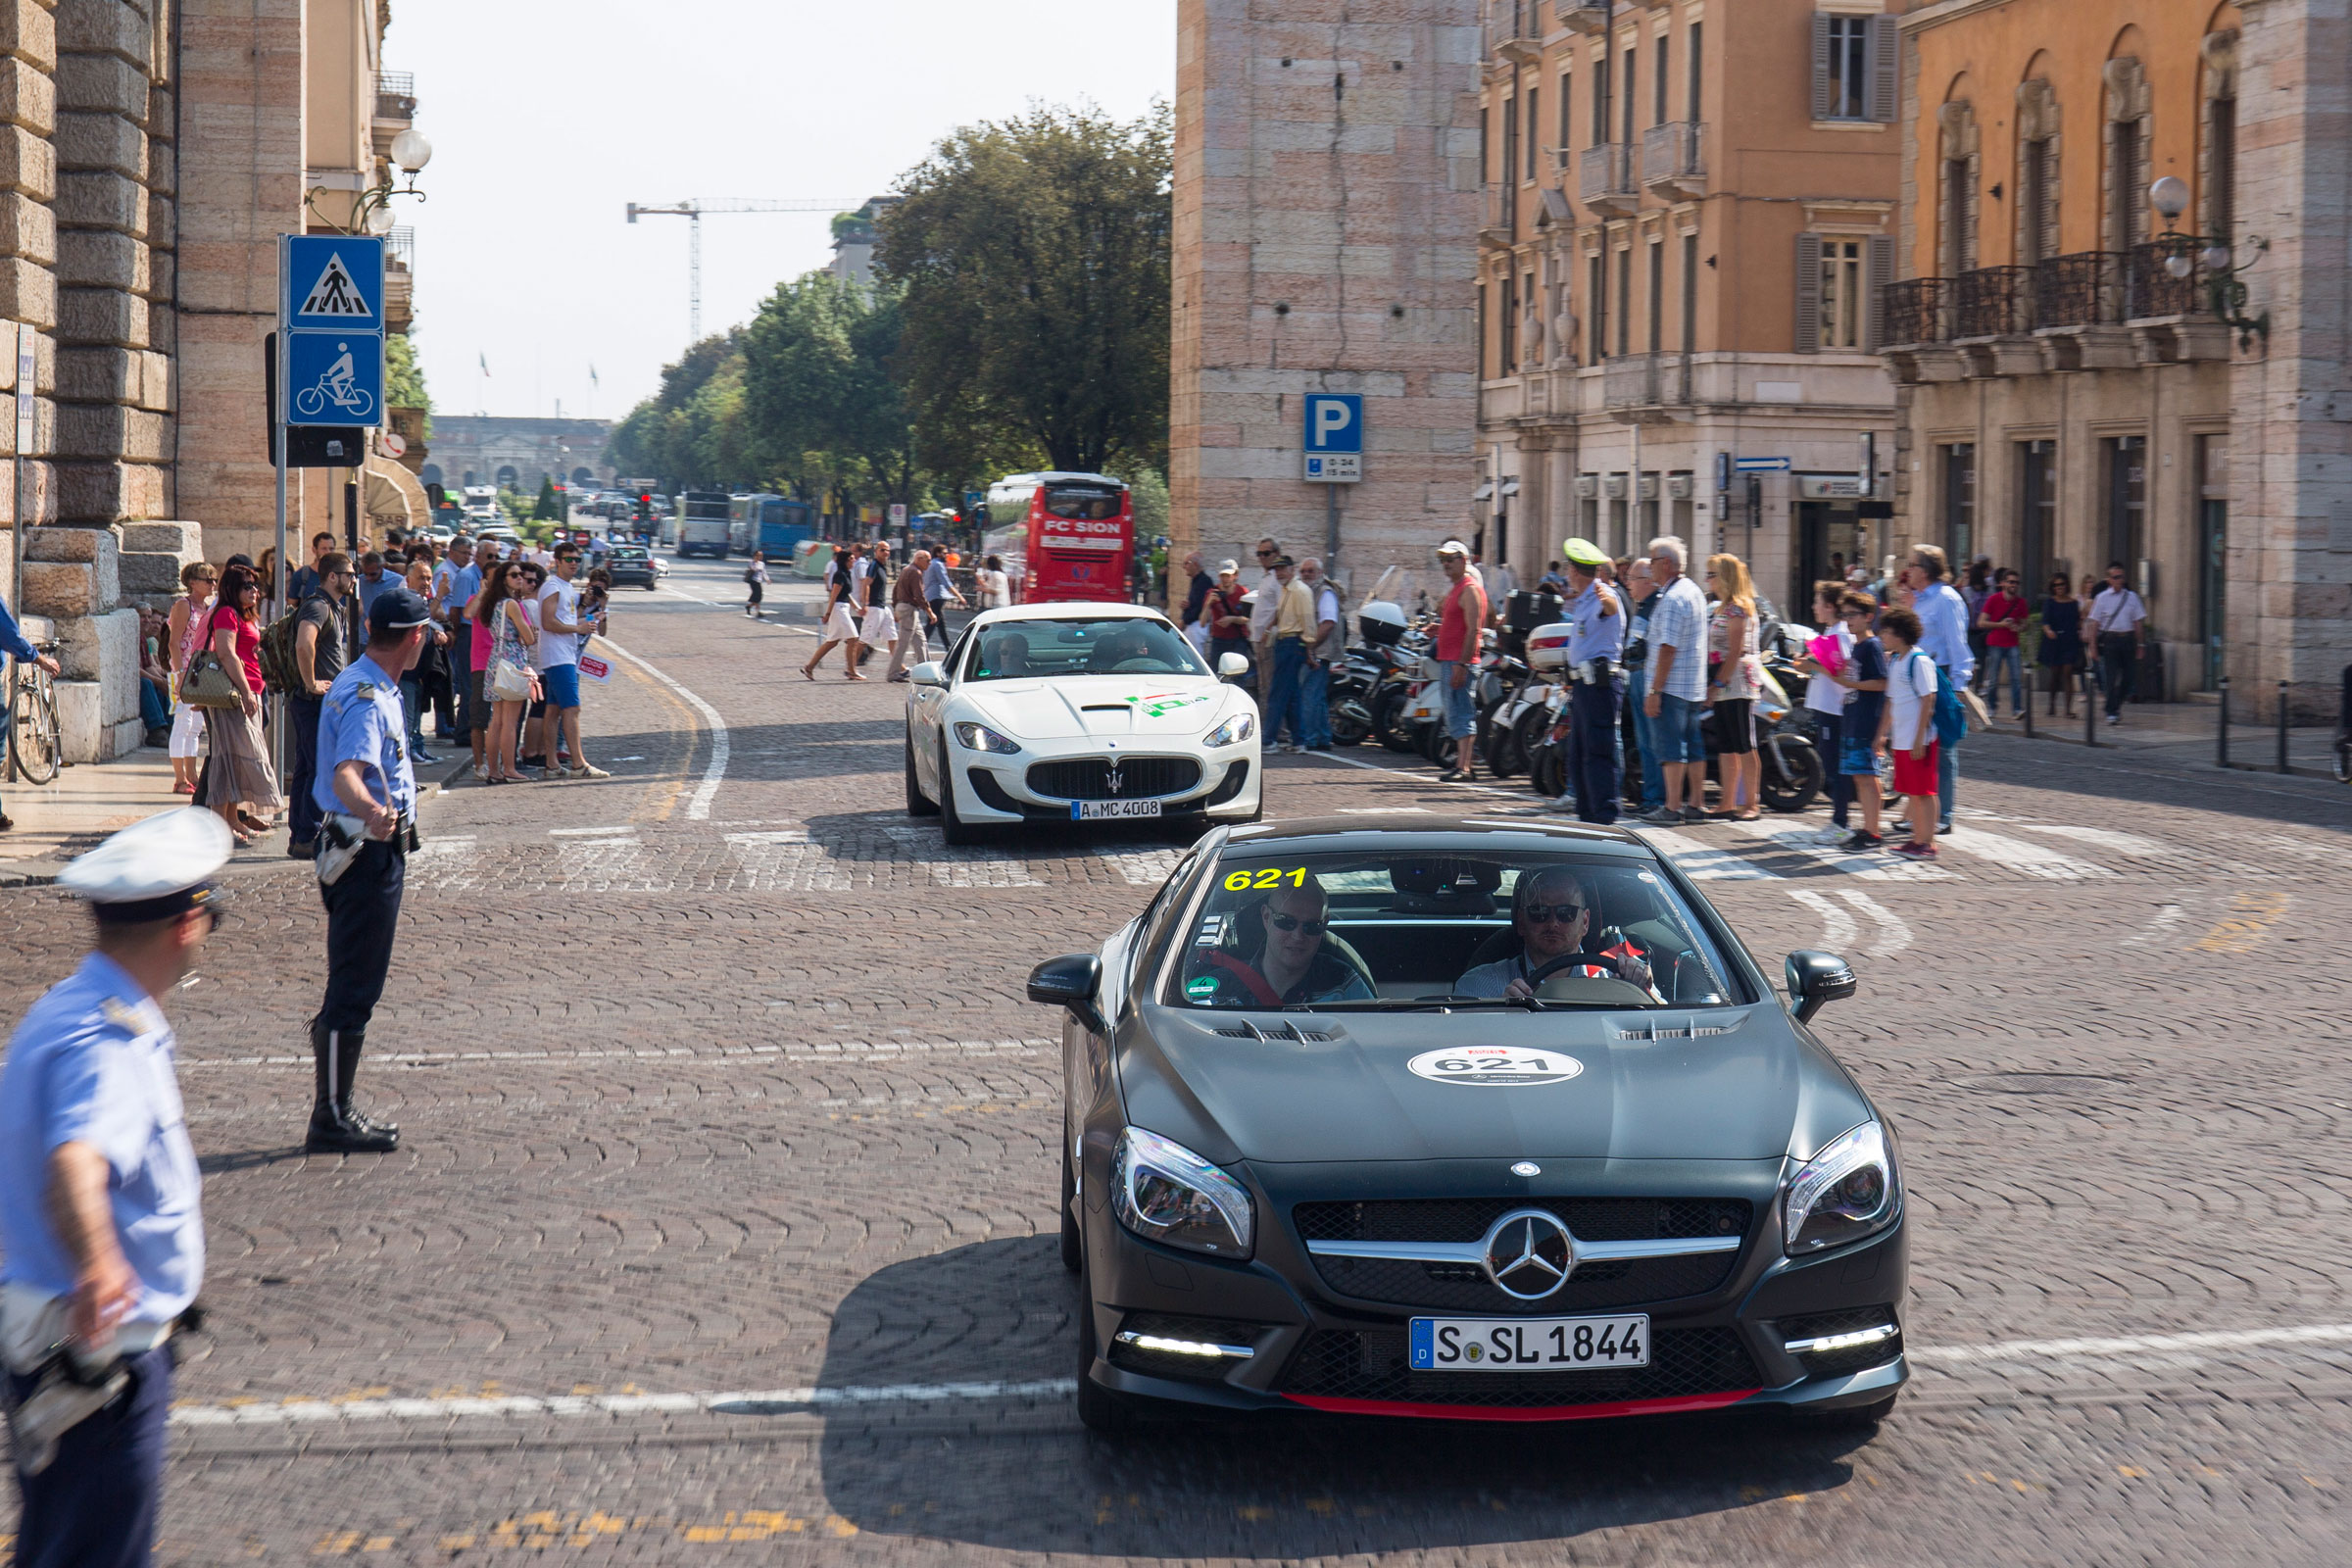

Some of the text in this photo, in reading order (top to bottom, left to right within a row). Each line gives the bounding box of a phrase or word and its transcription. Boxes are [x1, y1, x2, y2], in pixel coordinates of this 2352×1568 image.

[1314, 399, 1351, 447] P
[375, 514, 405, 526] BAR
[1044, 520, 1121, 534] FC SION
[1081, 801, 1158, 817] A MC 4008
[1224, 867, 1306, 892] 621
[1198, 977, 1207, 987] 4
[1434, 1057, 1549, 1071] 621
[1437, 1322, 1642, 1363] S SL 1844
[1418, 1348, 1427, 1359] D
